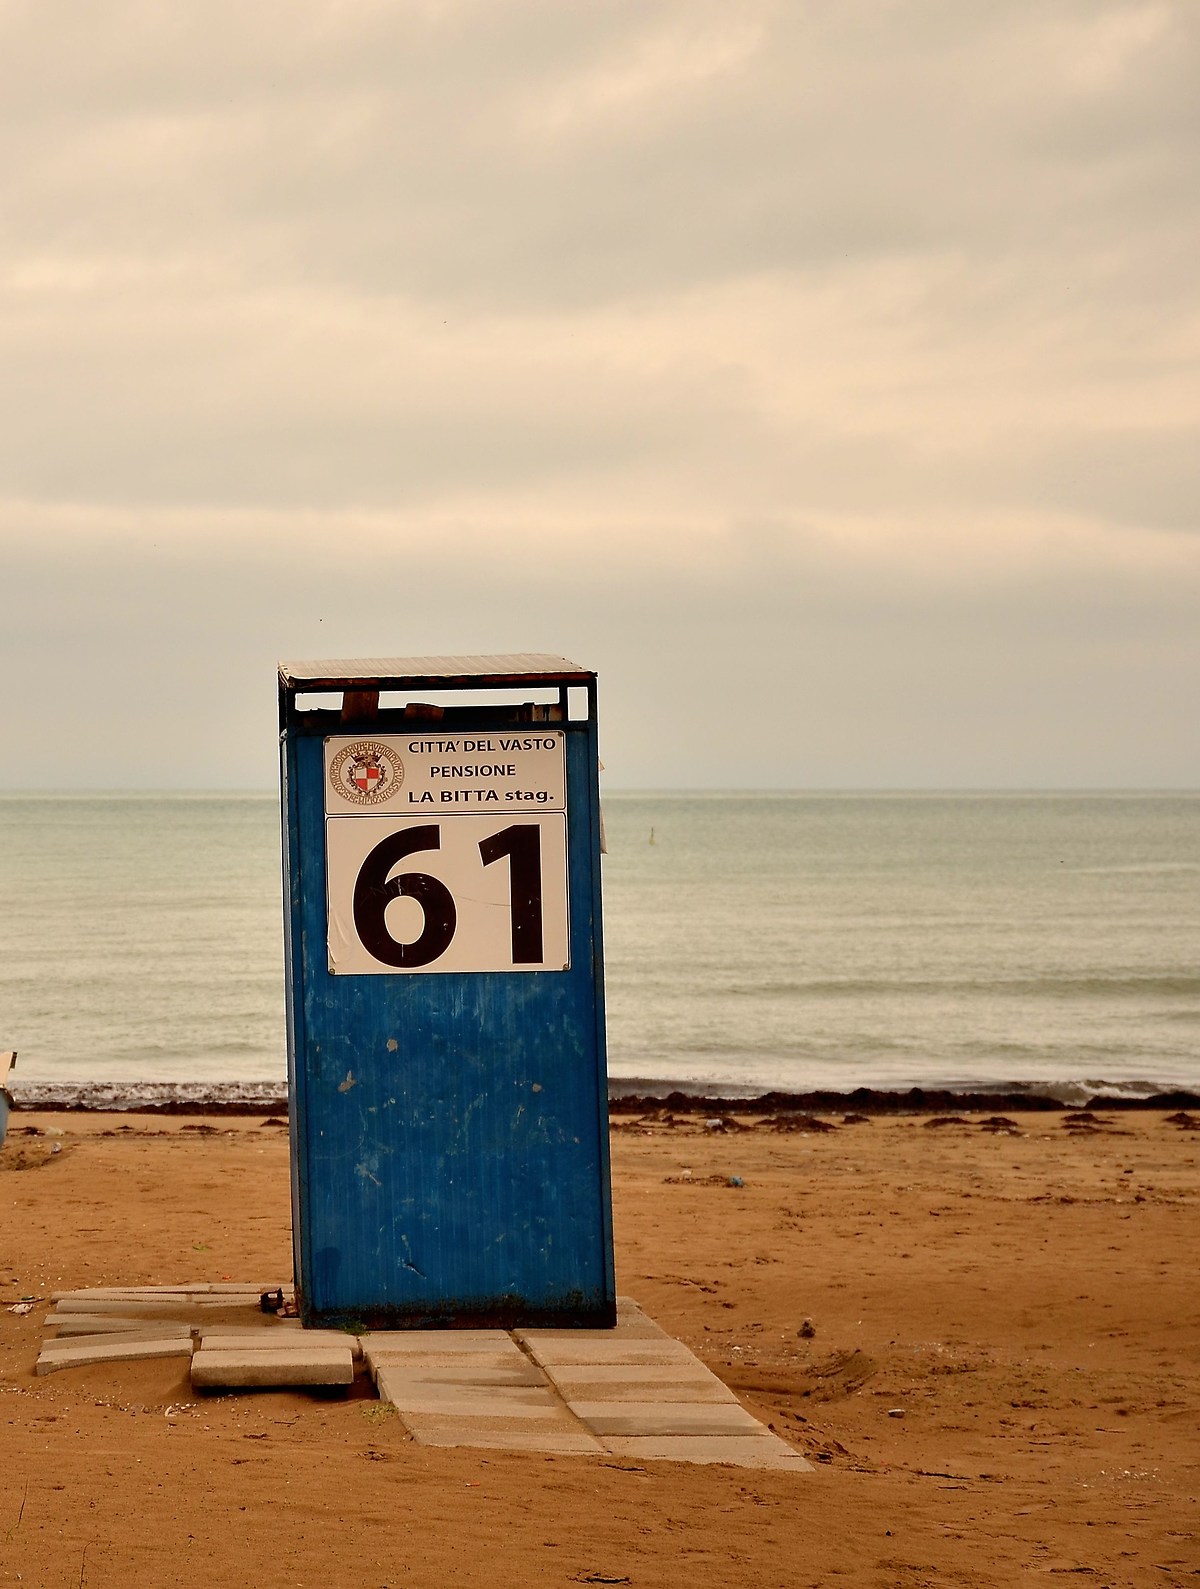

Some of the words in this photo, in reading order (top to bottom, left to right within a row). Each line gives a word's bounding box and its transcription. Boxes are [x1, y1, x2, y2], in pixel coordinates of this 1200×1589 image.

[463, 739, 496, 752] DEL
[498, 738, 556, 751] VASTO
[430, 764, 516, 778] PENSIONE
[408, 791, 435, 803] LA
[440, 789, 499, 803] BITTA
[504, 789, 555, 804] stag.
[353, 824, 544, 968] 61
